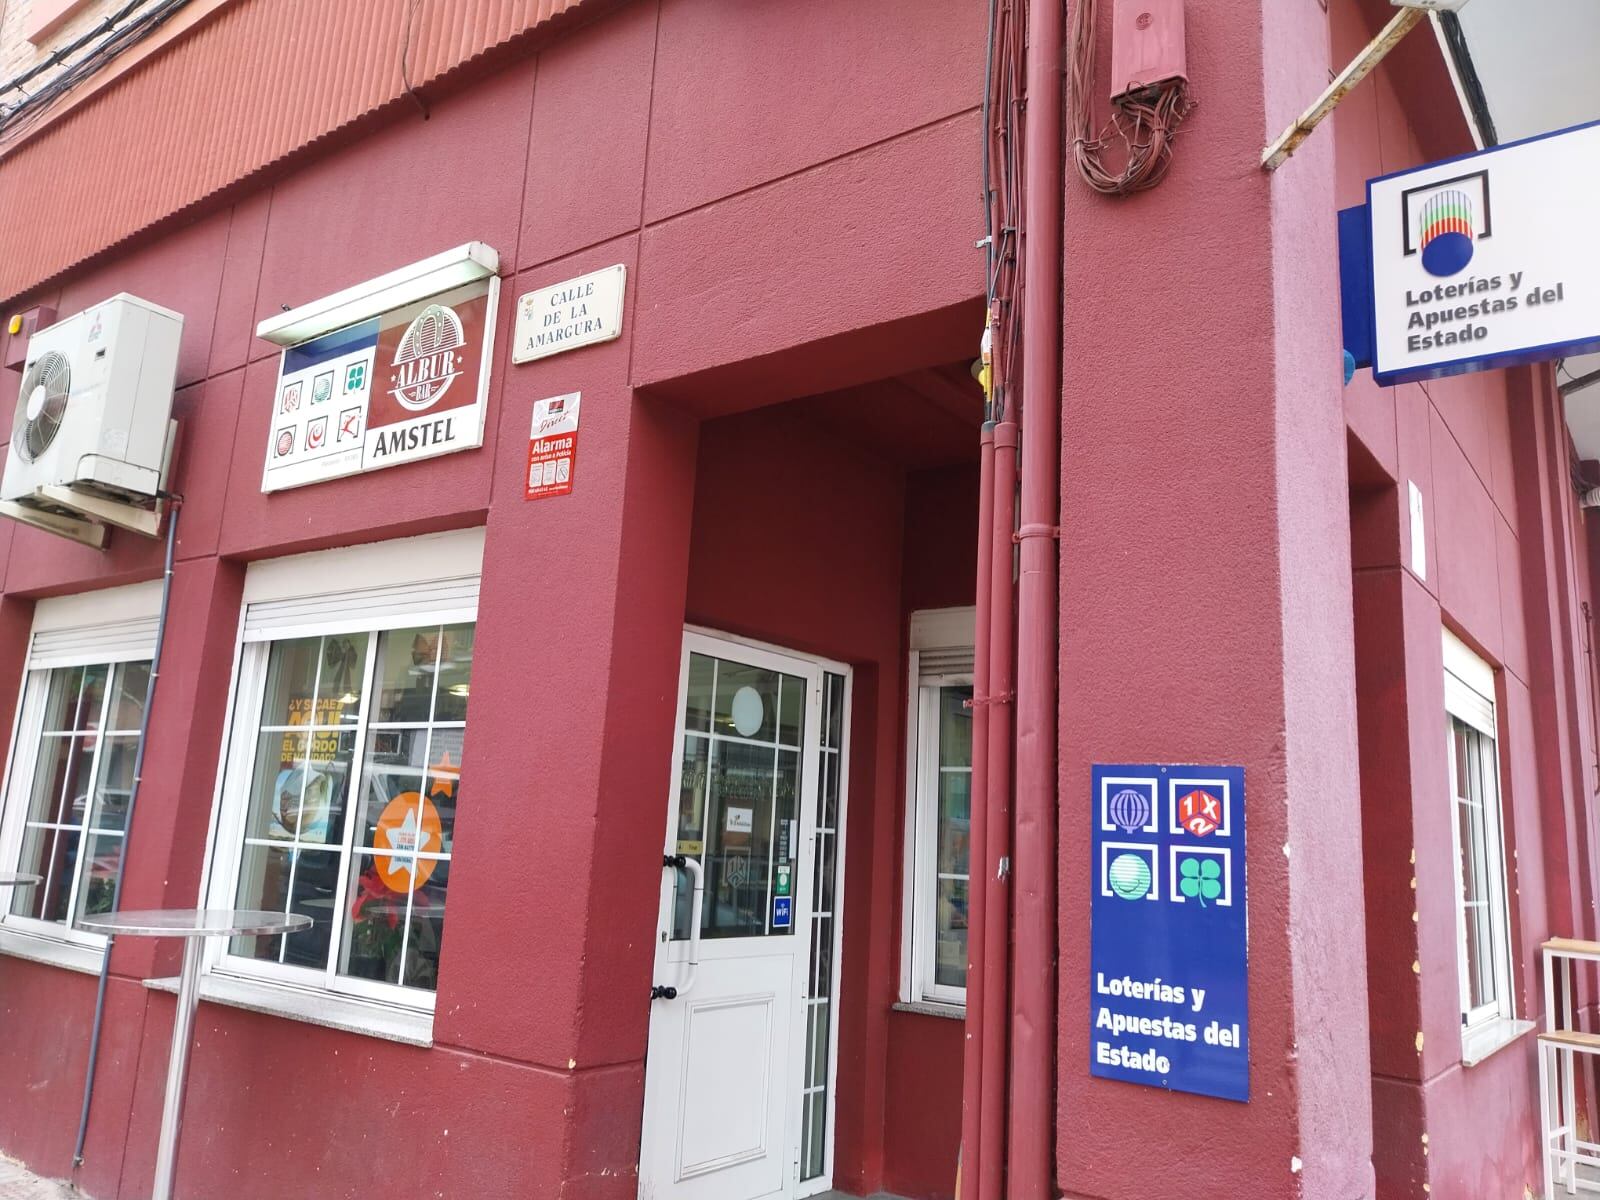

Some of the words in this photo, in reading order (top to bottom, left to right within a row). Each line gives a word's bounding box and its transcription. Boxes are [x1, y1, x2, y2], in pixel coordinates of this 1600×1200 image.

[551, 282, 594, 306] CALLE
[1406, 275, 1502, 307] Loterías
[1510, 271, 1523, 290] y
[543, 311, 561, 327] DE
[570, 303, 587, 319] LA
[1407, 296, 1519, 330] Apuestas
[1525, 282, 1564, 306] del
[526, 317, 602, 350] AMARGURA
[1407, 323, 1488, 353] Estado
[395, 352, 455, 388] ALBUR
[415, 383, 431, 401] BAR
[372, 418, 455, 458] AMSTEL
[532, 436, 572, 455] Alarma
[282, 740, 295, 752] EL
[1097, 972, 1185, 1004] Loterías
[1191, 988, 1206, 1012] y
[1096, 1007, 1197, 1042] Apuestas
[1203, 1021, 1240, 1048] del
[1097, 1041, 1170, 1074] Estado
